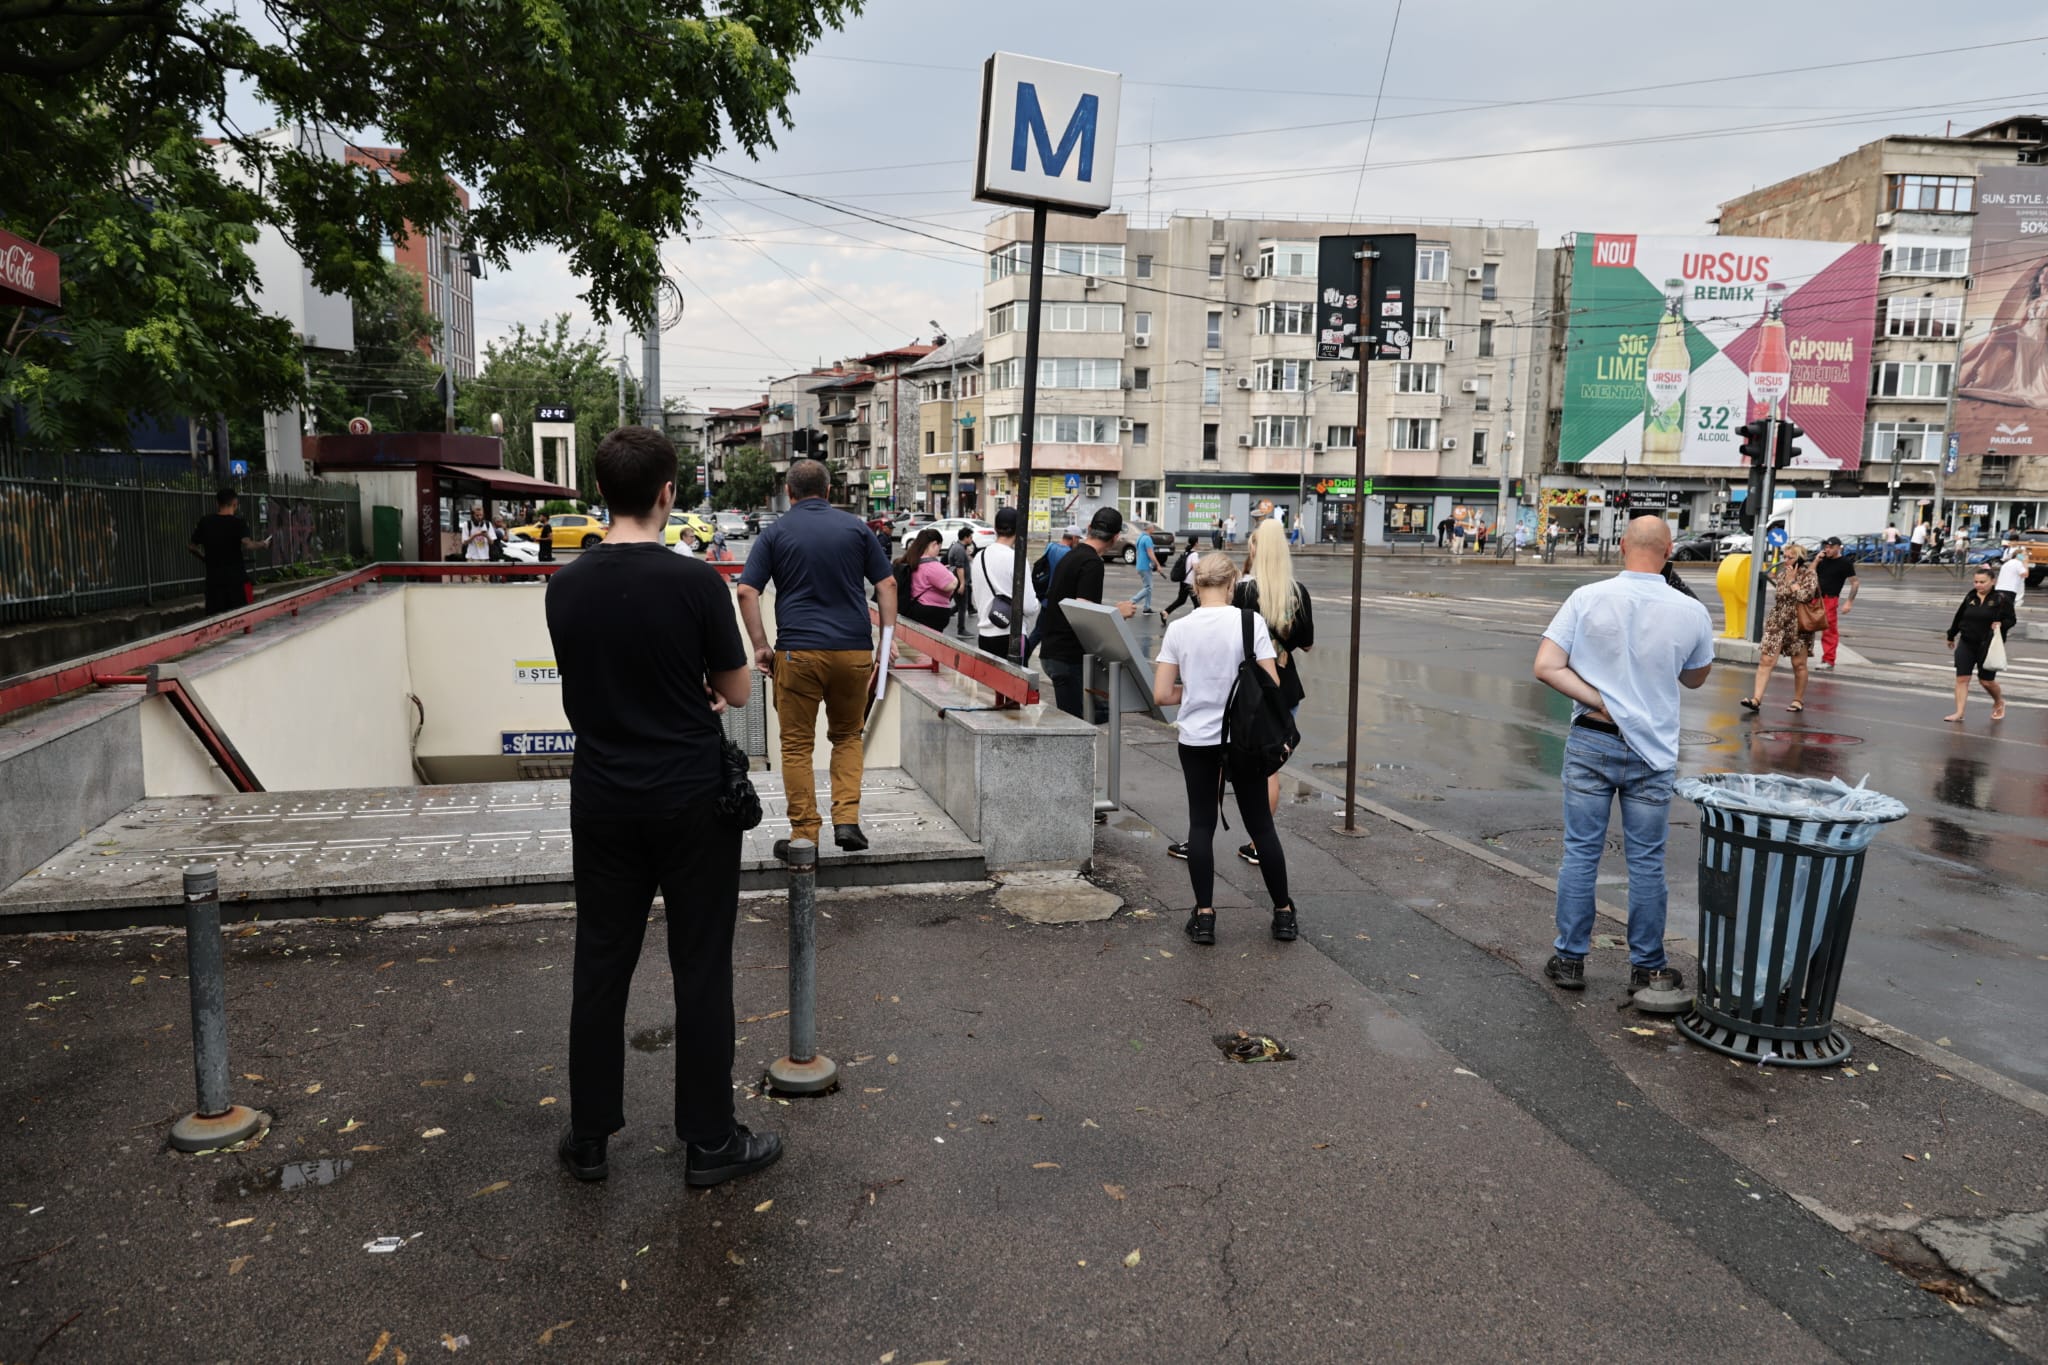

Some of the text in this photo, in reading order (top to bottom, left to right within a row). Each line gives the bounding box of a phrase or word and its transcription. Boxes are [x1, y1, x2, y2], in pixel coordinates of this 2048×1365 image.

[1011, 81, 1099, 182] M
[1981, 194, 2006, 204] SUN.
[2009, 194, 2044, 204] STYLE.
[1597, 242, 1631, 264] NOU
[1682, 252, 1770, 283] URSUS
[1694, 285, 1754, 301] REMIX
[1618, 334, 1648, 355] SOC
[1597, 356, 1647, 381] LIME
[1653, 372, 1682, 383] URSUS
[1755, 376, 1783, 387] URSUS
[541, 409, 552, 418] 22
[1698, 433, 1730, 441] ALCOOL
[519, 670, 526, 678] B
